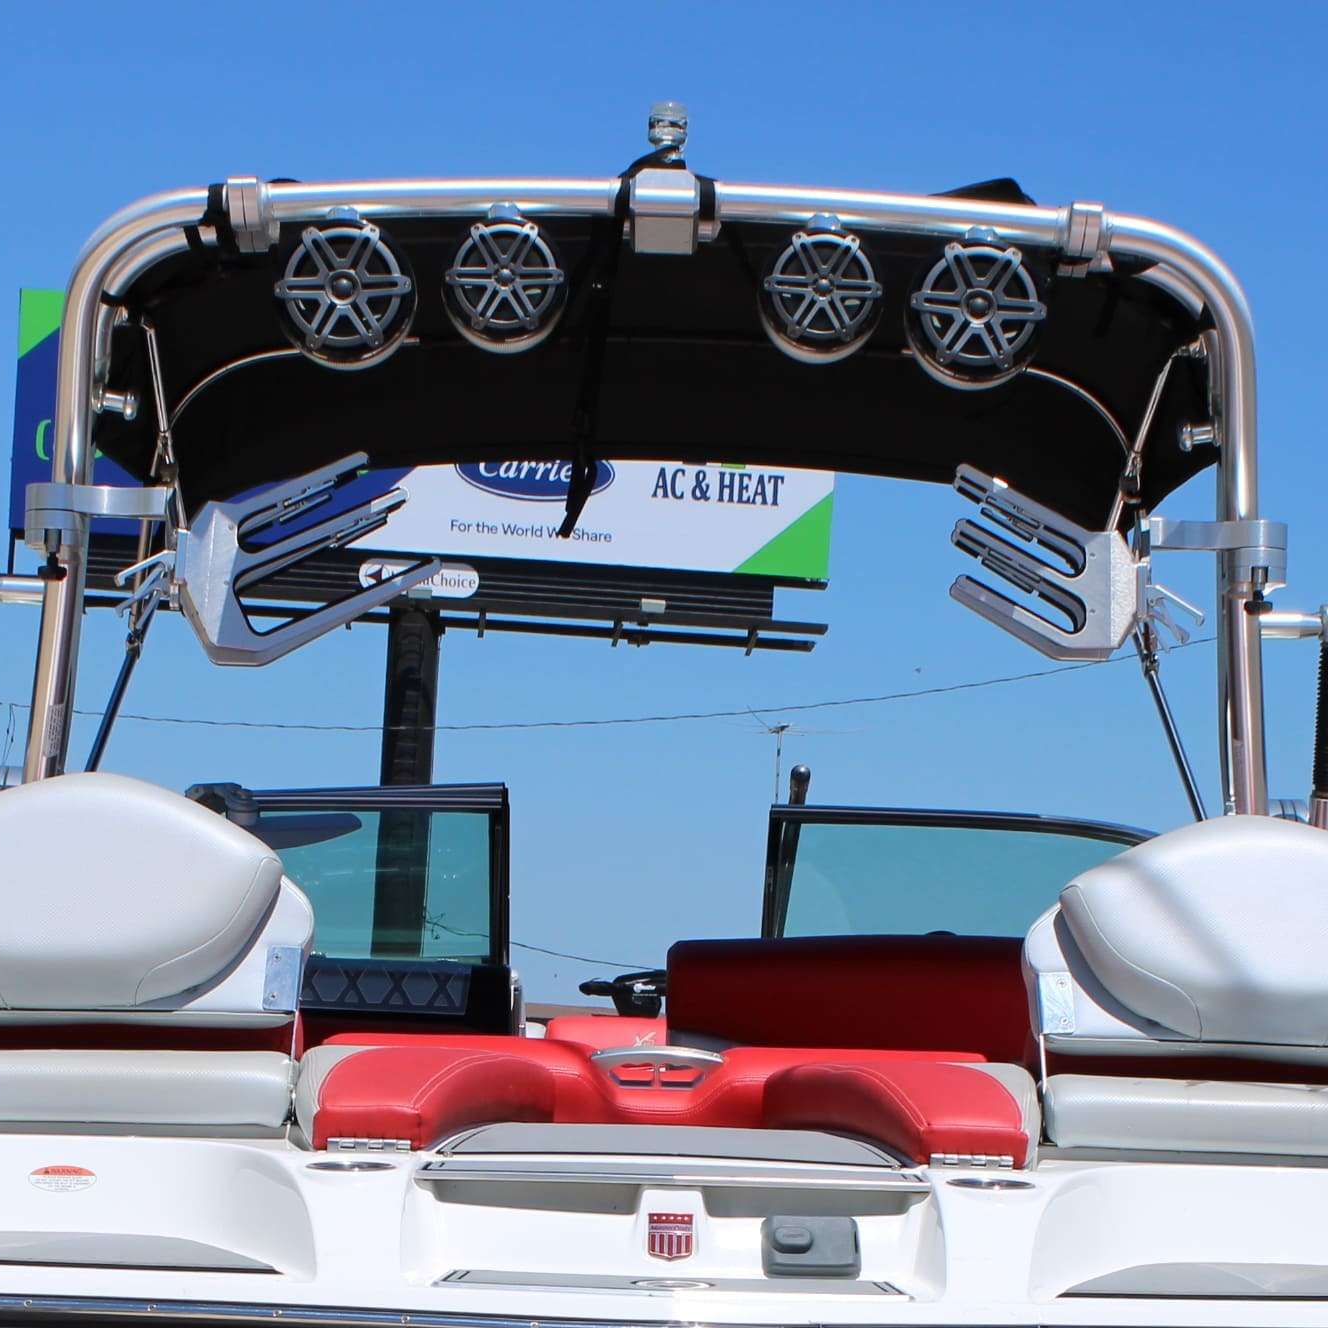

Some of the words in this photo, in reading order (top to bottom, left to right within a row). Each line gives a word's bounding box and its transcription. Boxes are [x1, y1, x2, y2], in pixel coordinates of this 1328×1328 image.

[478, 460, 589, 483] Carrie
[651, 467, 685, 500] AC
[691, 470, 711, 501] &
[717, 470, 785, 506] HEAT
[450, 519, 473, 533] For
[476, 520, 499, 535] the
[501, 522, 543, 538] World
[572, 528, 613, 543] Share
